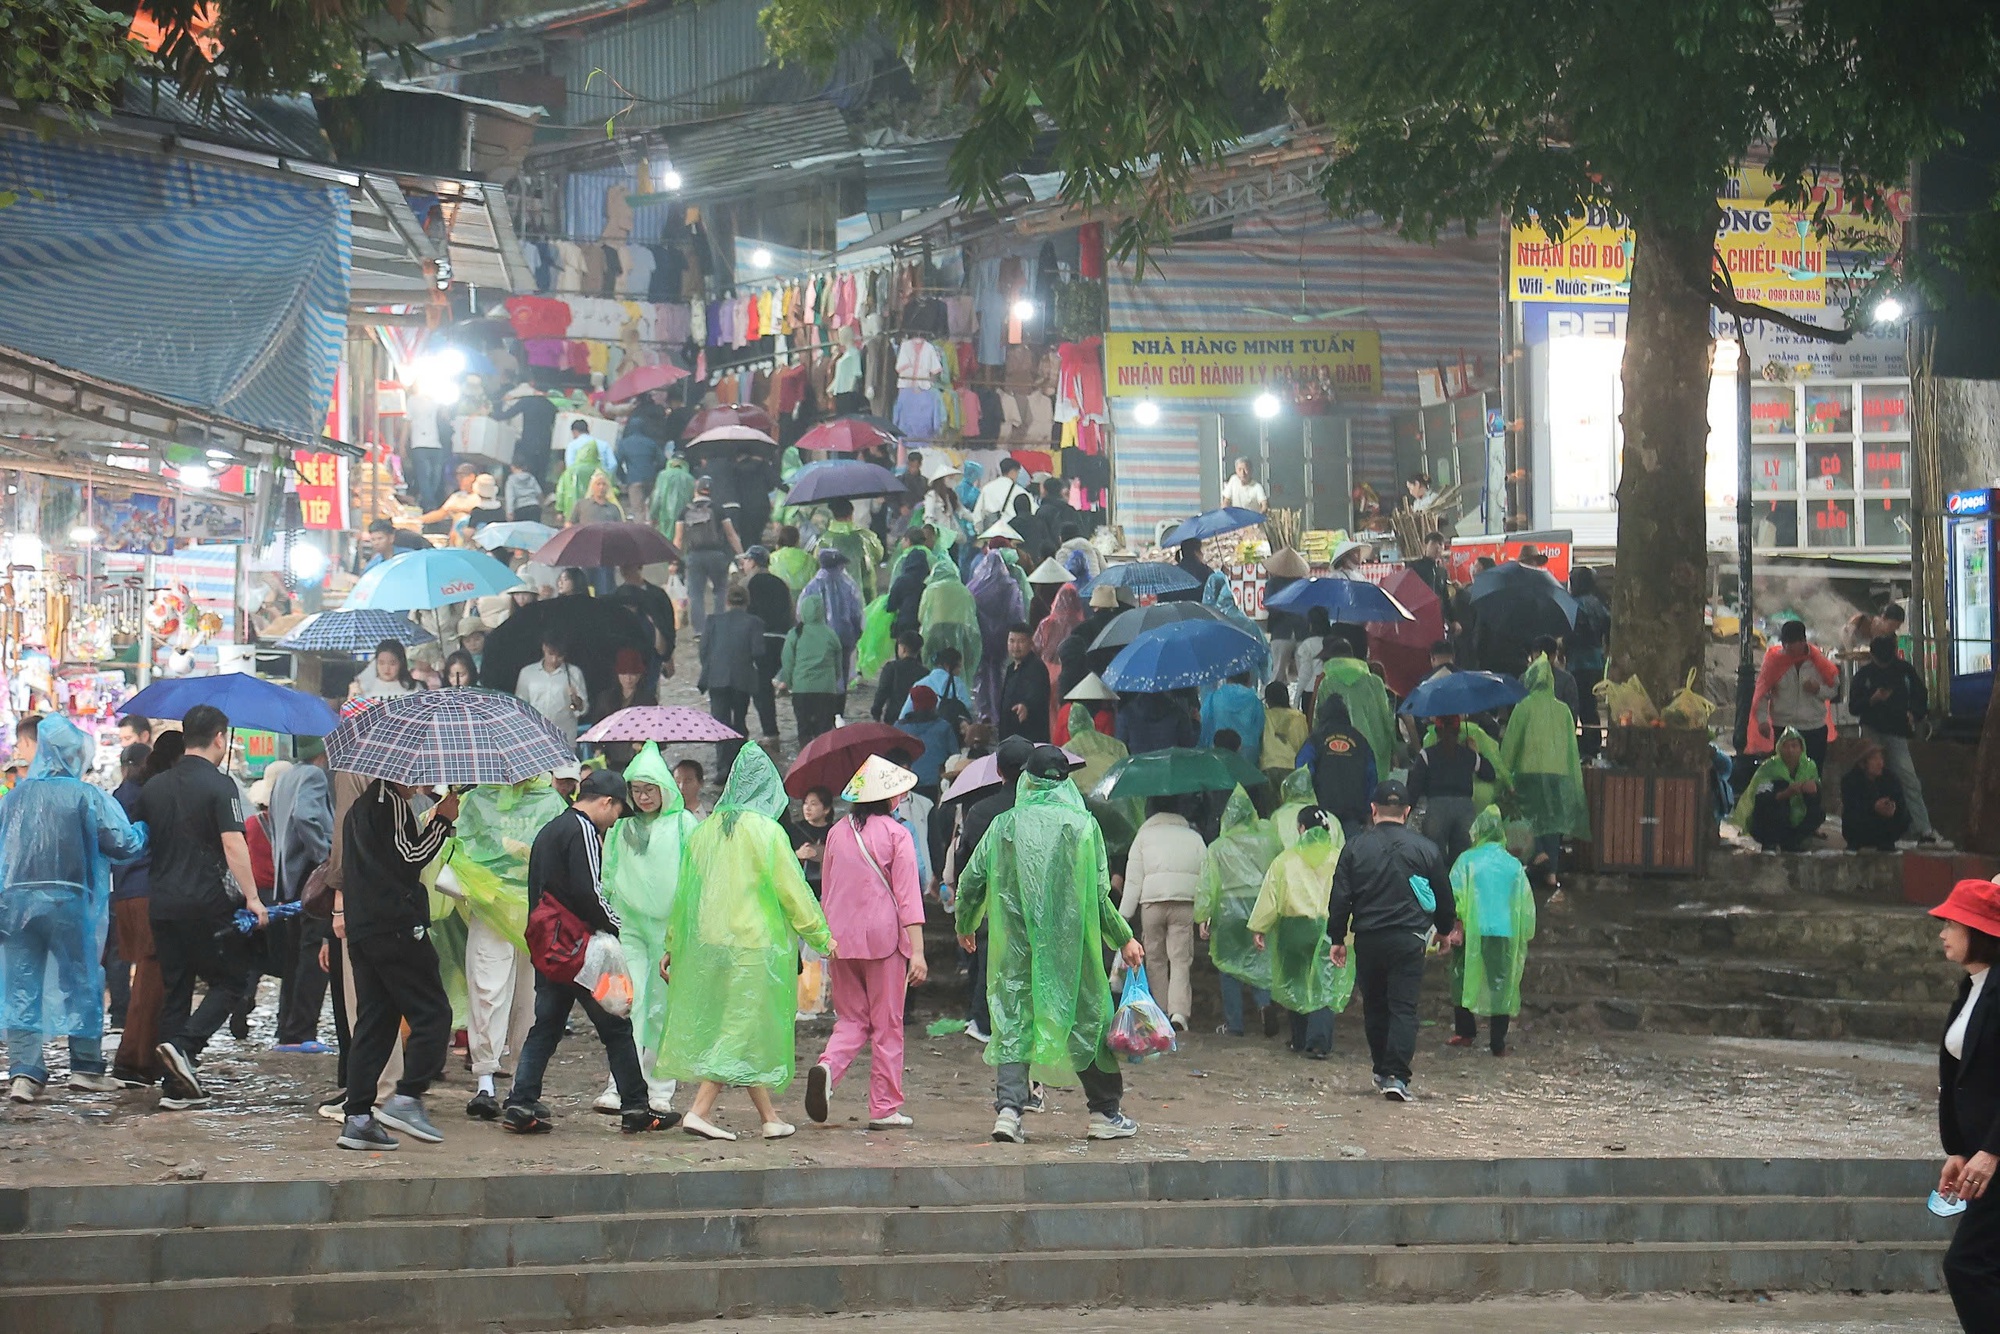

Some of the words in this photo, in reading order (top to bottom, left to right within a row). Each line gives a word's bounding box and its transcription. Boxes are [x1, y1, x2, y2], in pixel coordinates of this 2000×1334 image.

[1719, 206, 1772, 237] ỢNG
[1517, 238, 1564, 273] NHẬN
[1569, 236, 1597, 269] GỬI
[1727, 242, 1776, 274] CHIẾU
[1518, 277, 1543, 295] Wifi
[1555, 278, 1587, 296] Nước
[1746, 288, 1761, 301] 842
[1768, 287, 1788, 301] 0989
[1789, 287, 1804, 301] 630
[1132, 336, 1176, 355] NHÀ
[1181, 336, 1237, 355] HÀNG
[1243, 340, 1295, 355] MINH
[1299, 332, 1355, 354] TUẤN
[1118, 361, 1164, 390] NHẬN
[1169, 357, 1196, 385] GỬI
[1201, 361, 1244, 385] HÀNH
[1249, 361, 1267, 385] LÝ
[1961, 492, 1986, 512] pepsi
[1537, 547, 1561, 558] rino
